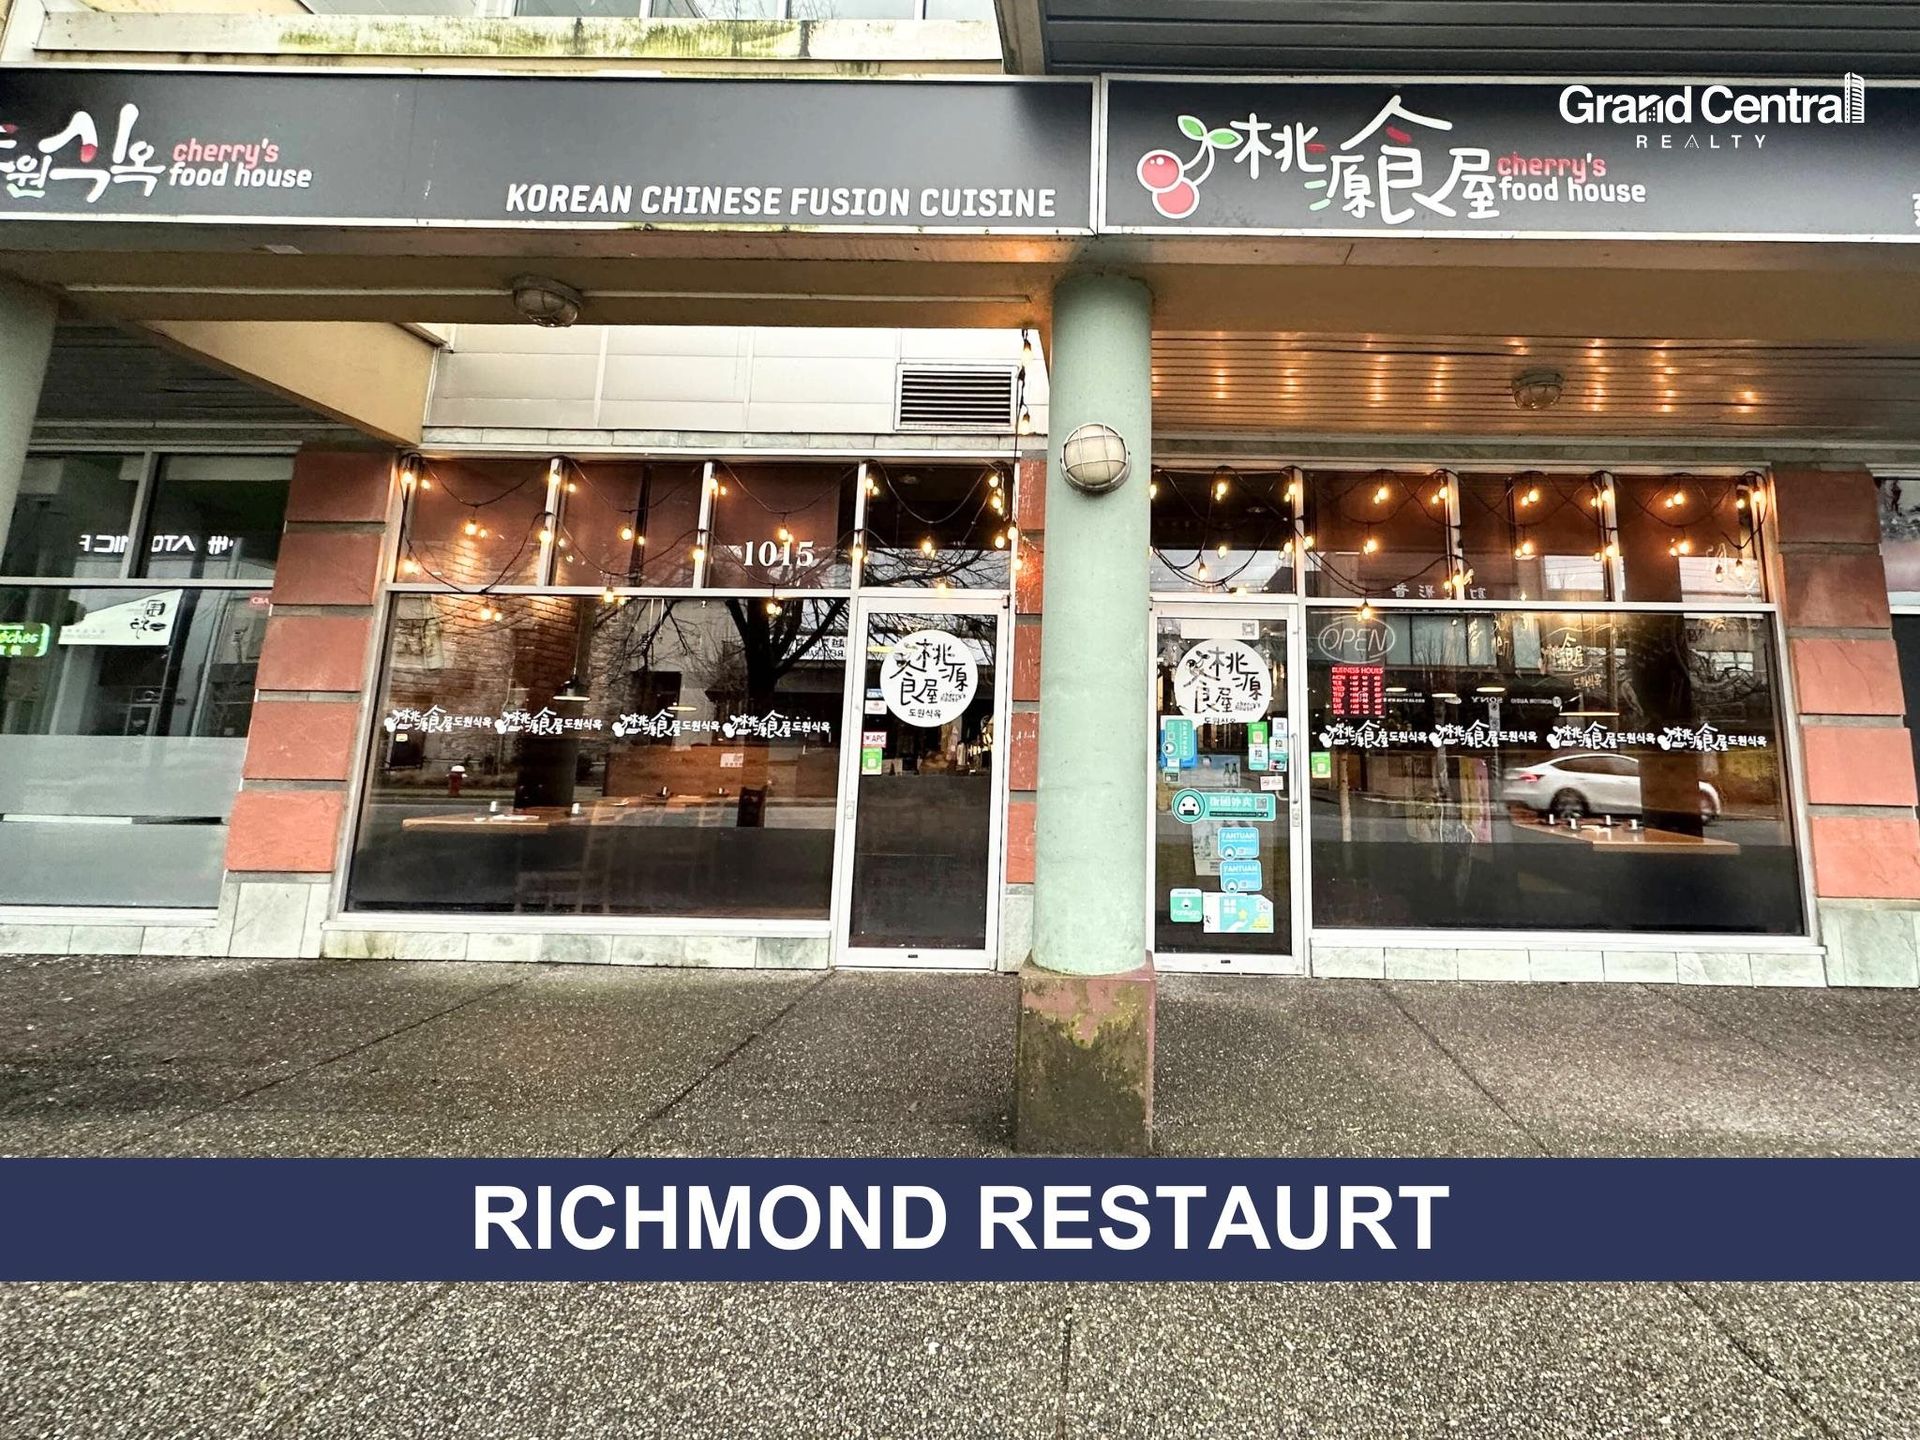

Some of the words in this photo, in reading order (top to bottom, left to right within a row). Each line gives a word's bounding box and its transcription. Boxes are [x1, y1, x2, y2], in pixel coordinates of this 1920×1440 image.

[172, 138, 279, 169] cherry's
[1498, 151, 1606, 183] cherry's
[169, 161, 226, 187] food
[234, 163, 313, 189] house
[506, 183, 632, 214] KOREAN
[641, 185, 782, 216] CHINESE
[791, 187, 910, 217] FUSION
[920, 188, 1056, 218] CUISINE
[1499, 176, 1560, 202] food
[1567, 177, 1647, 203] house
[743, 541, 814, 567] 1015
[1323, 628, 1388, 652] OPEN
